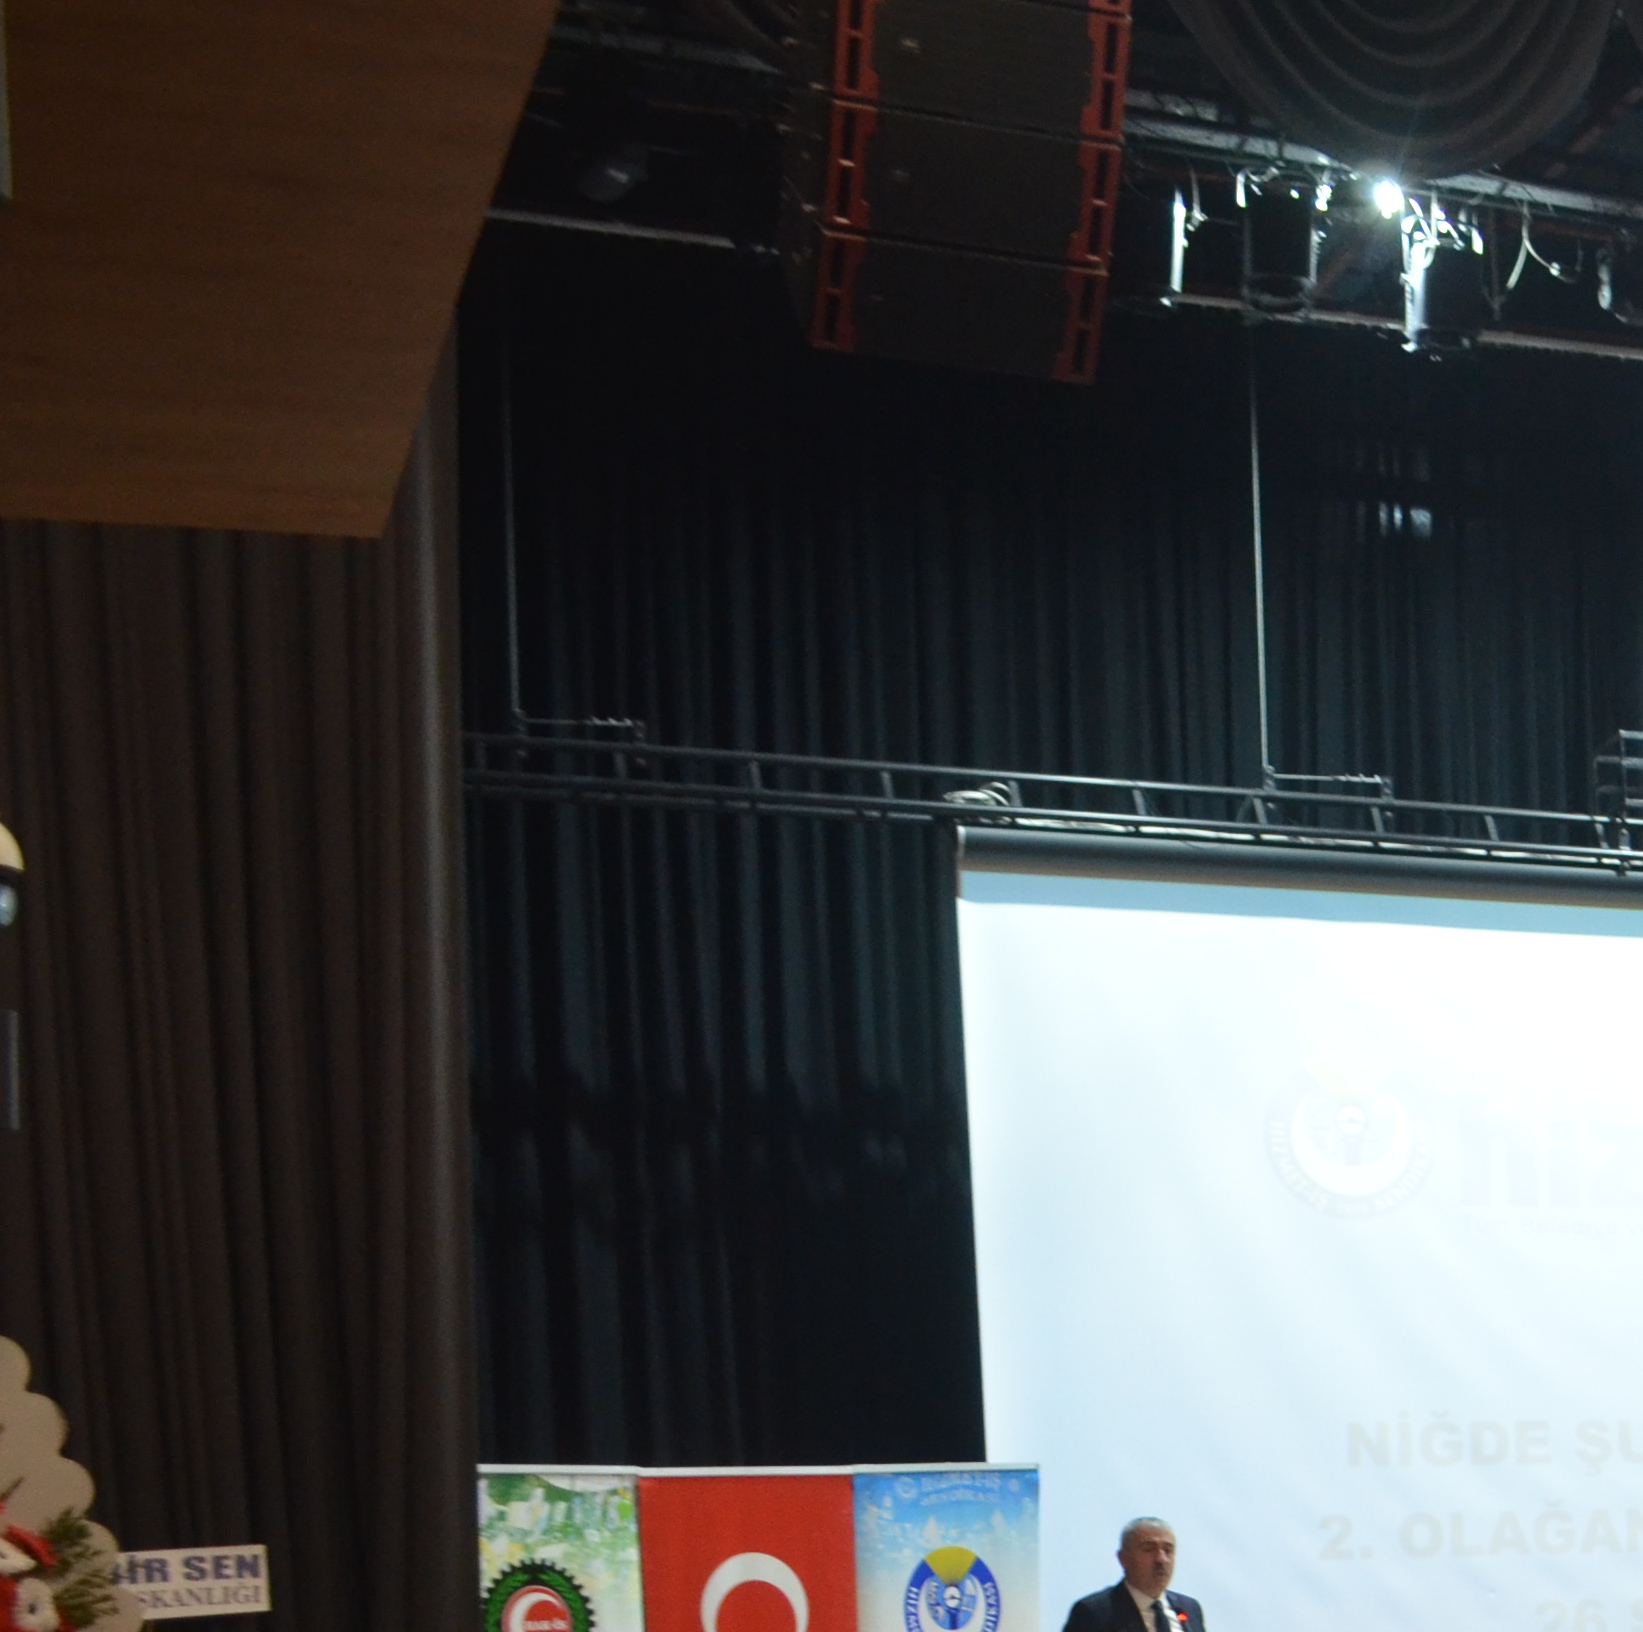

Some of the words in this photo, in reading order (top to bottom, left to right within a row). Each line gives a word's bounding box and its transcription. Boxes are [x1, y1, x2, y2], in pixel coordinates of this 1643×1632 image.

[1346, 1410, 1553, 1468] NİĞDE
[1318, 1512, 1375, 1562] 2.
[182, 1554, 261, 1581] SEN
